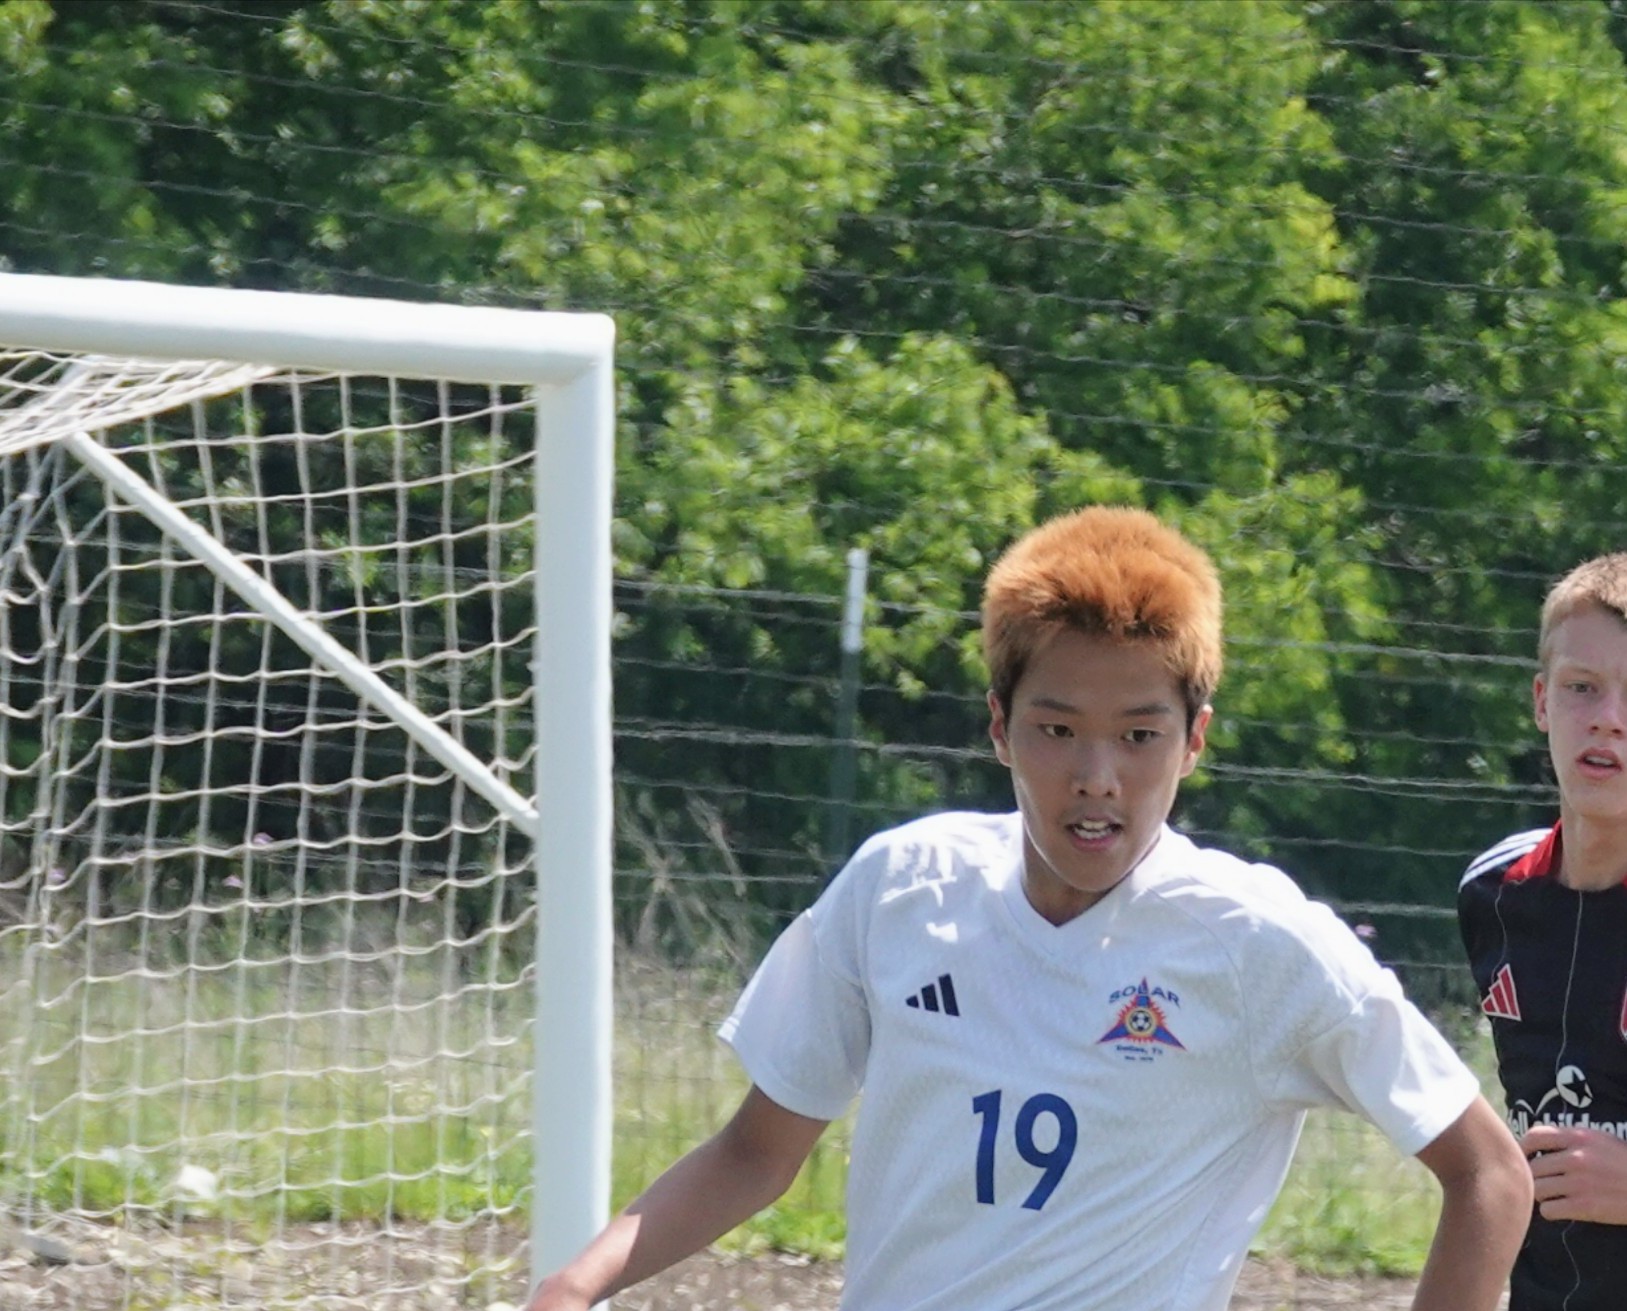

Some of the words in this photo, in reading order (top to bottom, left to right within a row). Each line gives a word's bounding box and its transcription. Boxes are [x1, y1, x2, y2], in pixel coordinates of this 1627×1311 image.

[1109, 984, 1181, 1009] SOLAR
[1532, 1112, 1627, 1141] hilden
[972, 1089, 1078, 1211] 19
